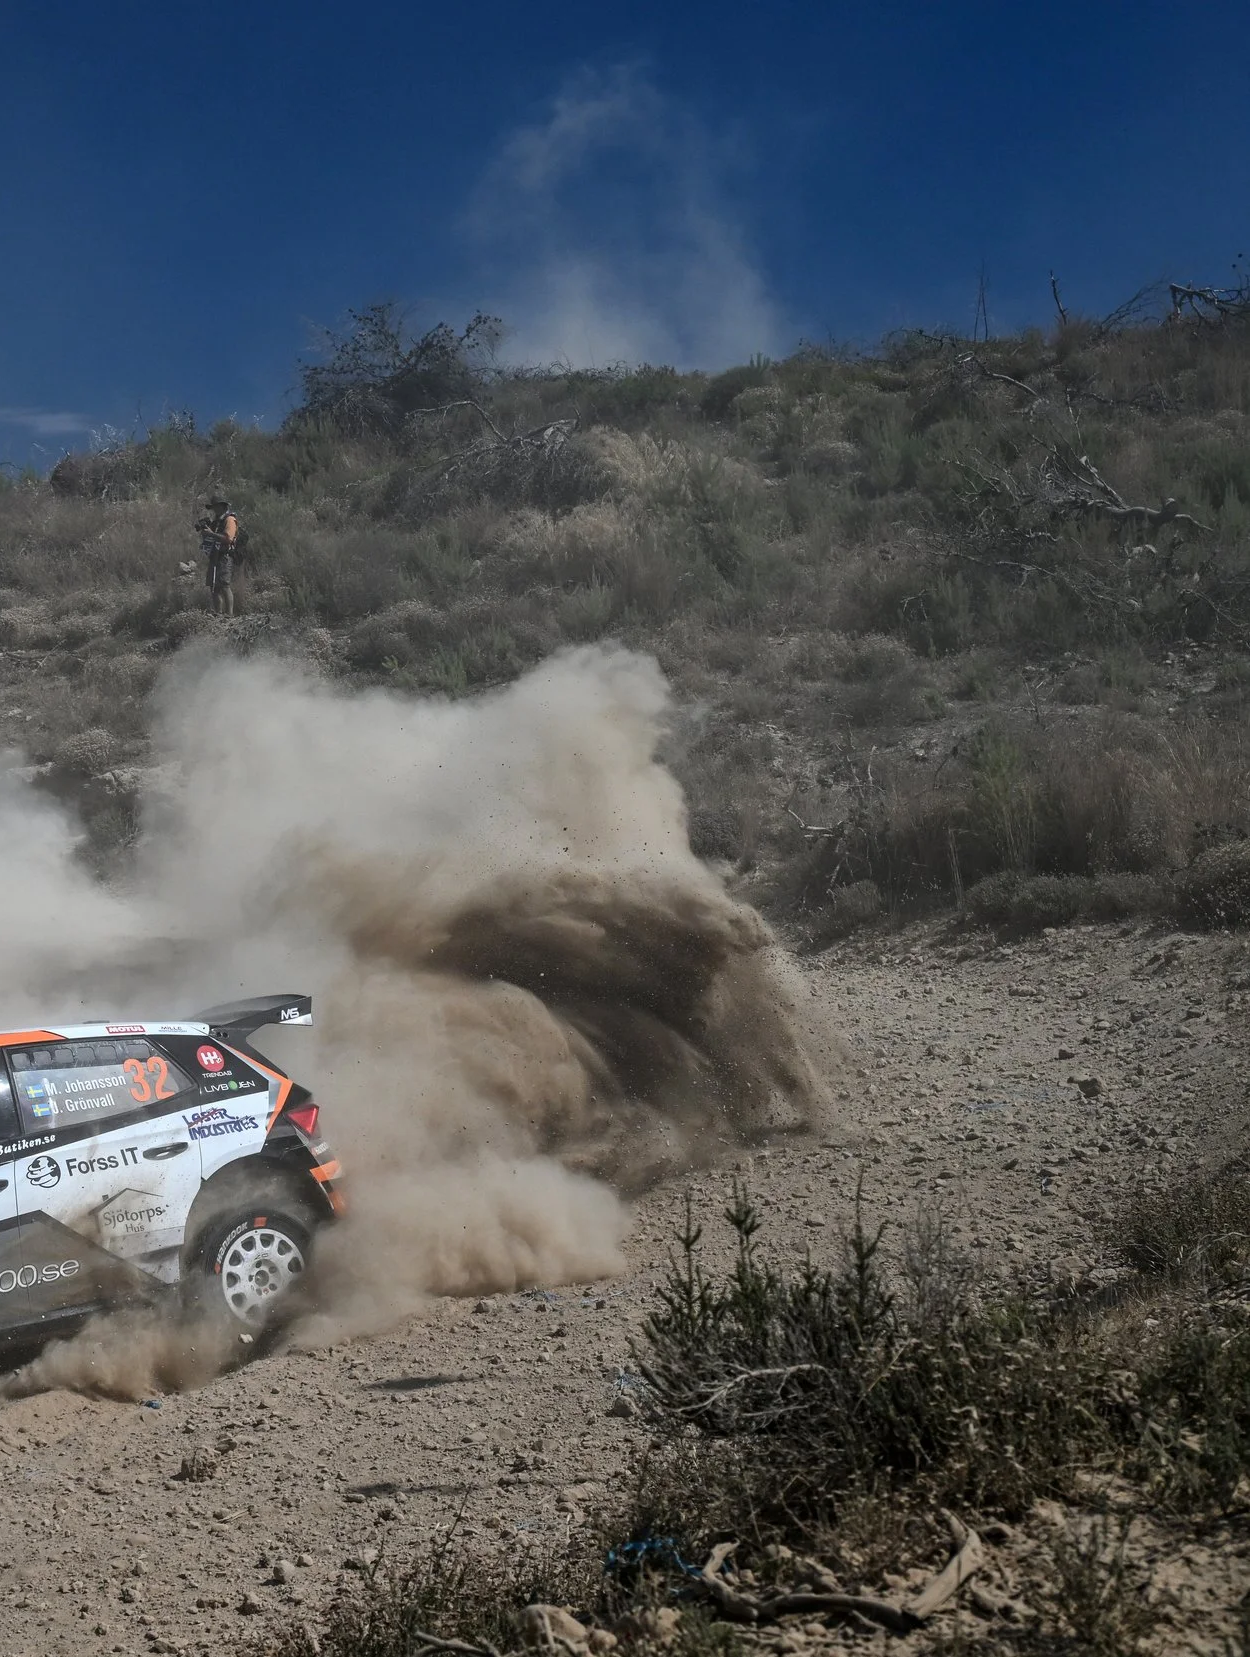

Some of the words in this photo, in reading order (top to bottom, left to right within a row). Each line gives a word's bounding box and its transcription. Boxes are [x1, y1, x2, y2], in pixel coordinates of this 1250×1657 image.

[281, 1007, 299, 1020] MS
[108, 1025, 144, 1033] MOTUL
[44, 1082, 61, 1096] M.
[65, 1075, 127, 1094] Johansson
[123, 1056, 175, 1102] 32
[51, 1100, 63, 1115] J.
[65, 1093, 115, 1112] Grönvall
[188, 1115, 259, 1140] INDUSTRIES
[66, 1155, 120, 1176] Forss
[122, 1147, 139, 1166] IT
[103, 1206, 163, 1229] Sjötorps
[125, 1223, 145, 1233] Hus
